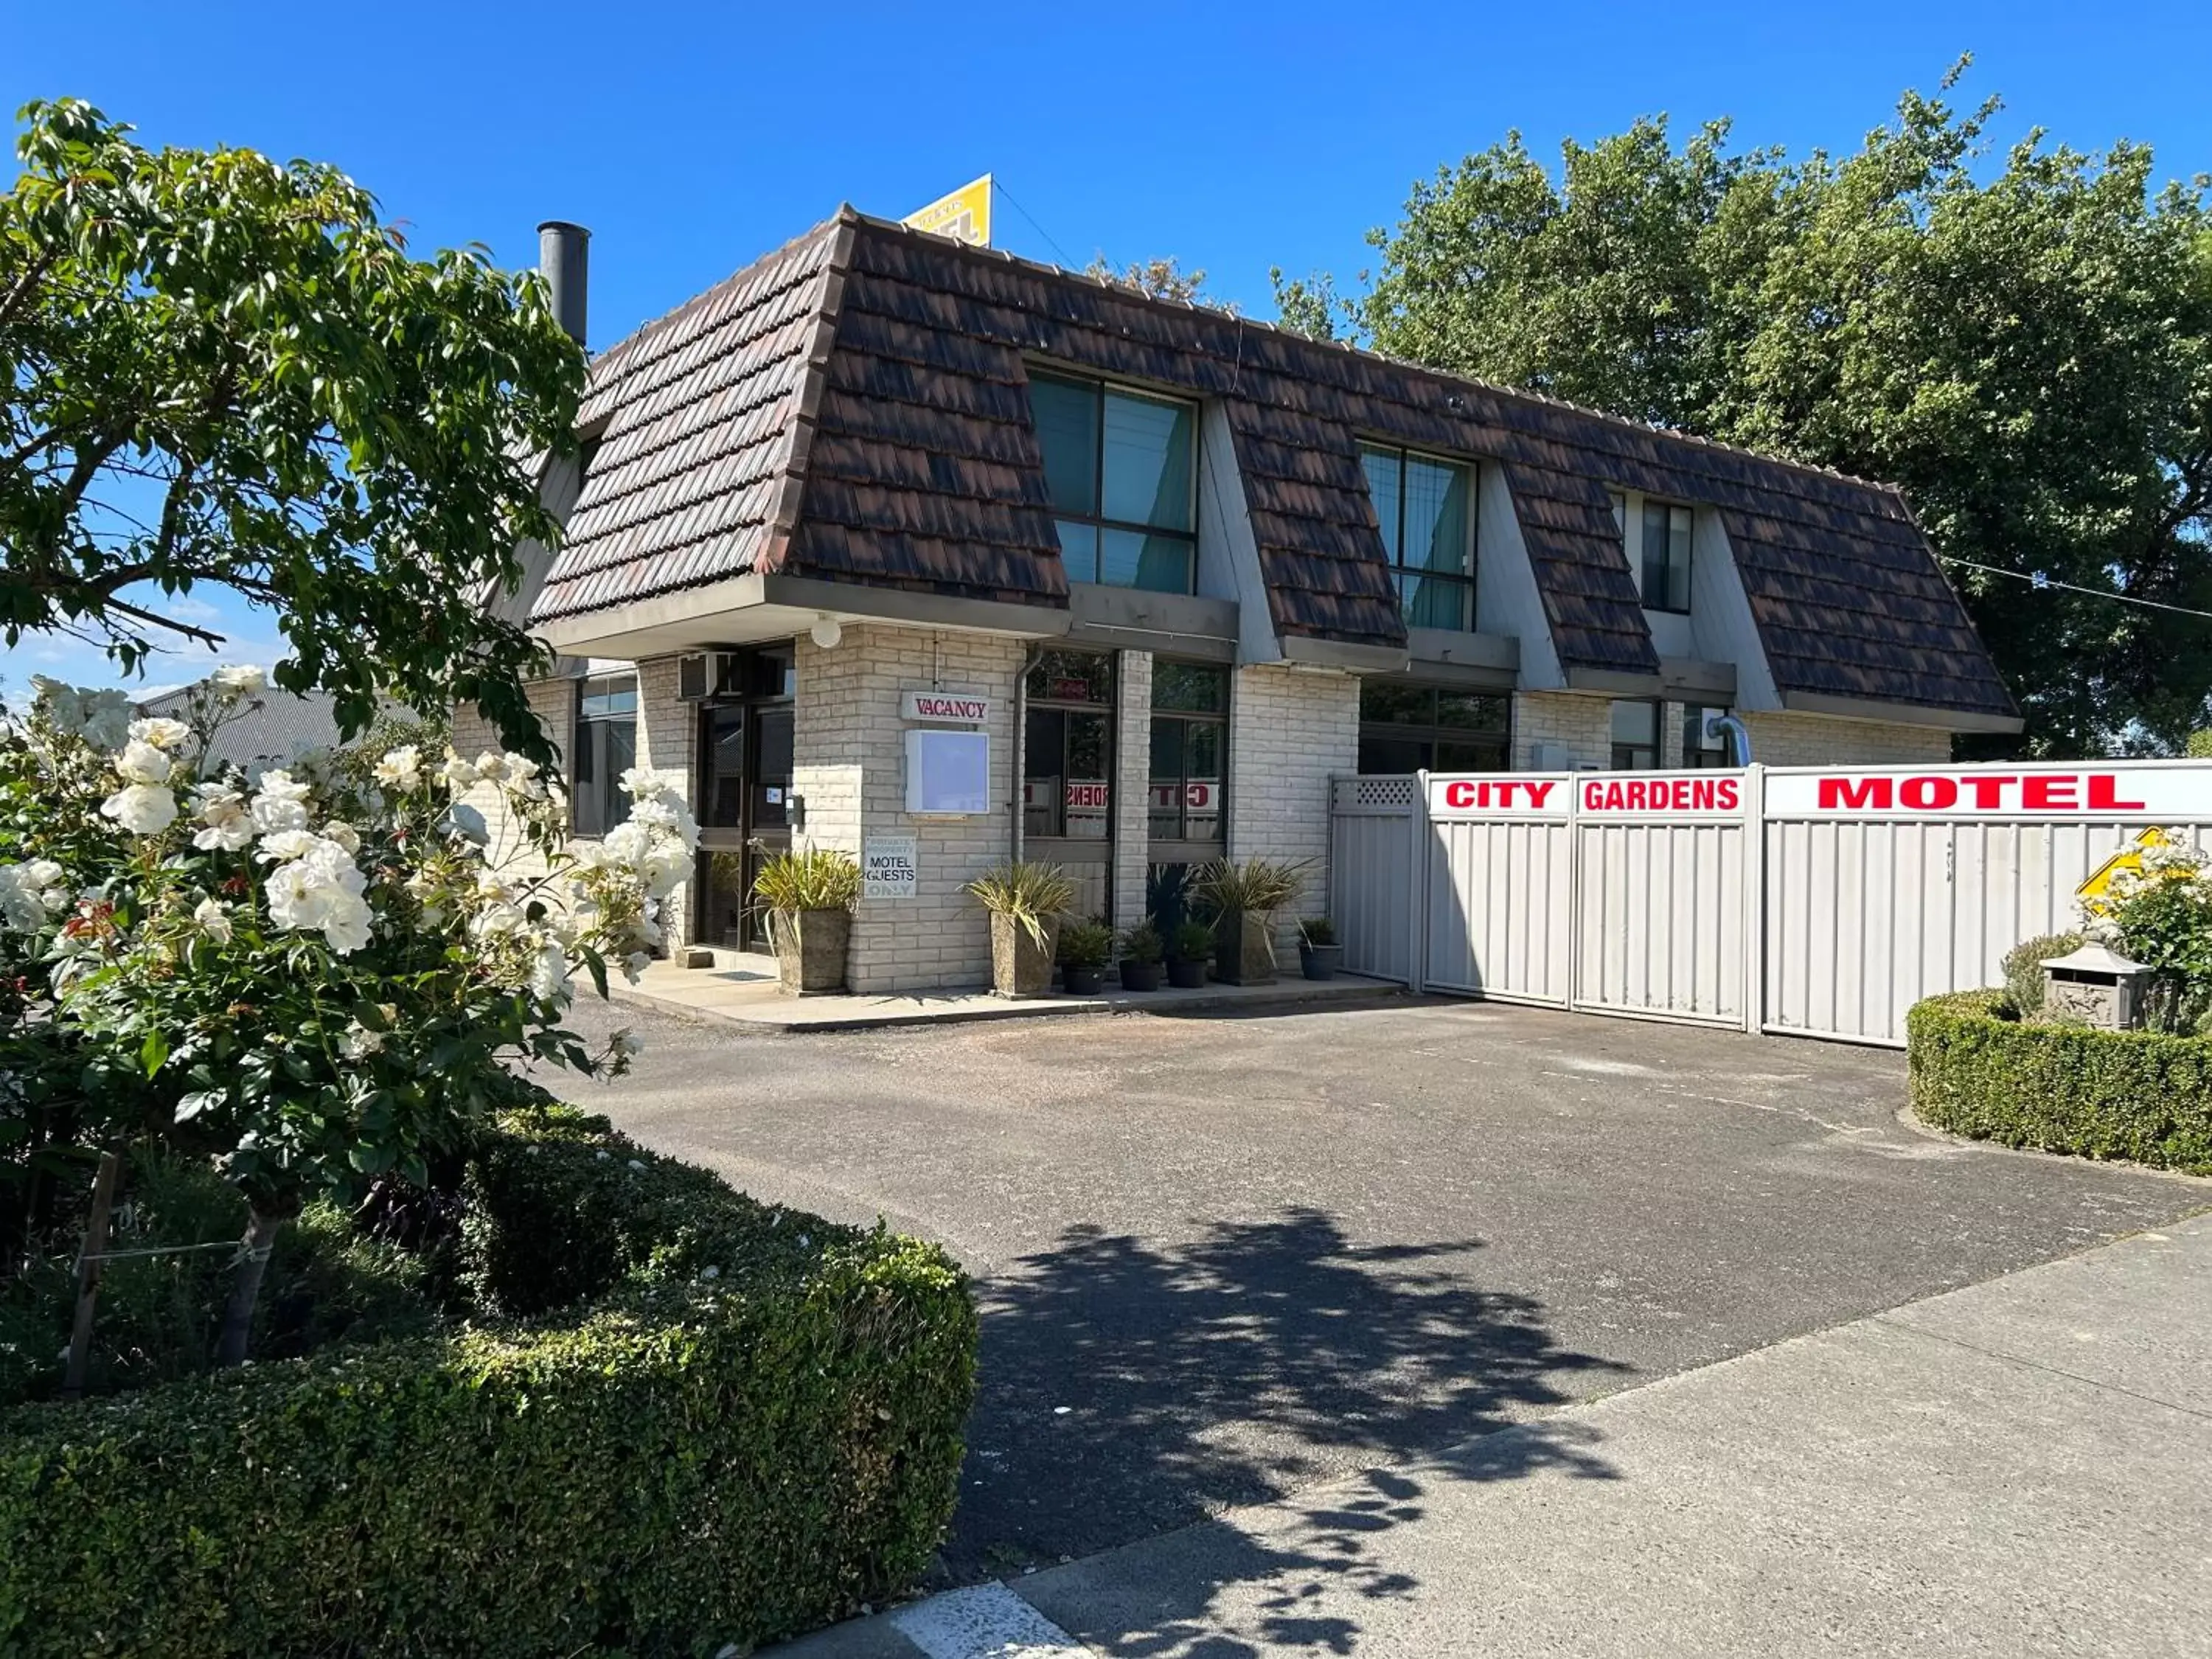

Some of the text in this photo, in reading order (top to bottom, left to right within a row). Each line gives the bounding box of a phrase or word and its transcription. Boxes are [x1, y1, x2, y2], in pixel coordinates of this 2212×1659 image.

[916, 698, 987, 718] VACANCY
[1446, 775, 2146, 810] CITY GARDENS MOTEL
[870, 856, 911, 868] MOTEL
[866, 869, 915, 881] GUESTS
[868, 885, 911, 896] ONLY
